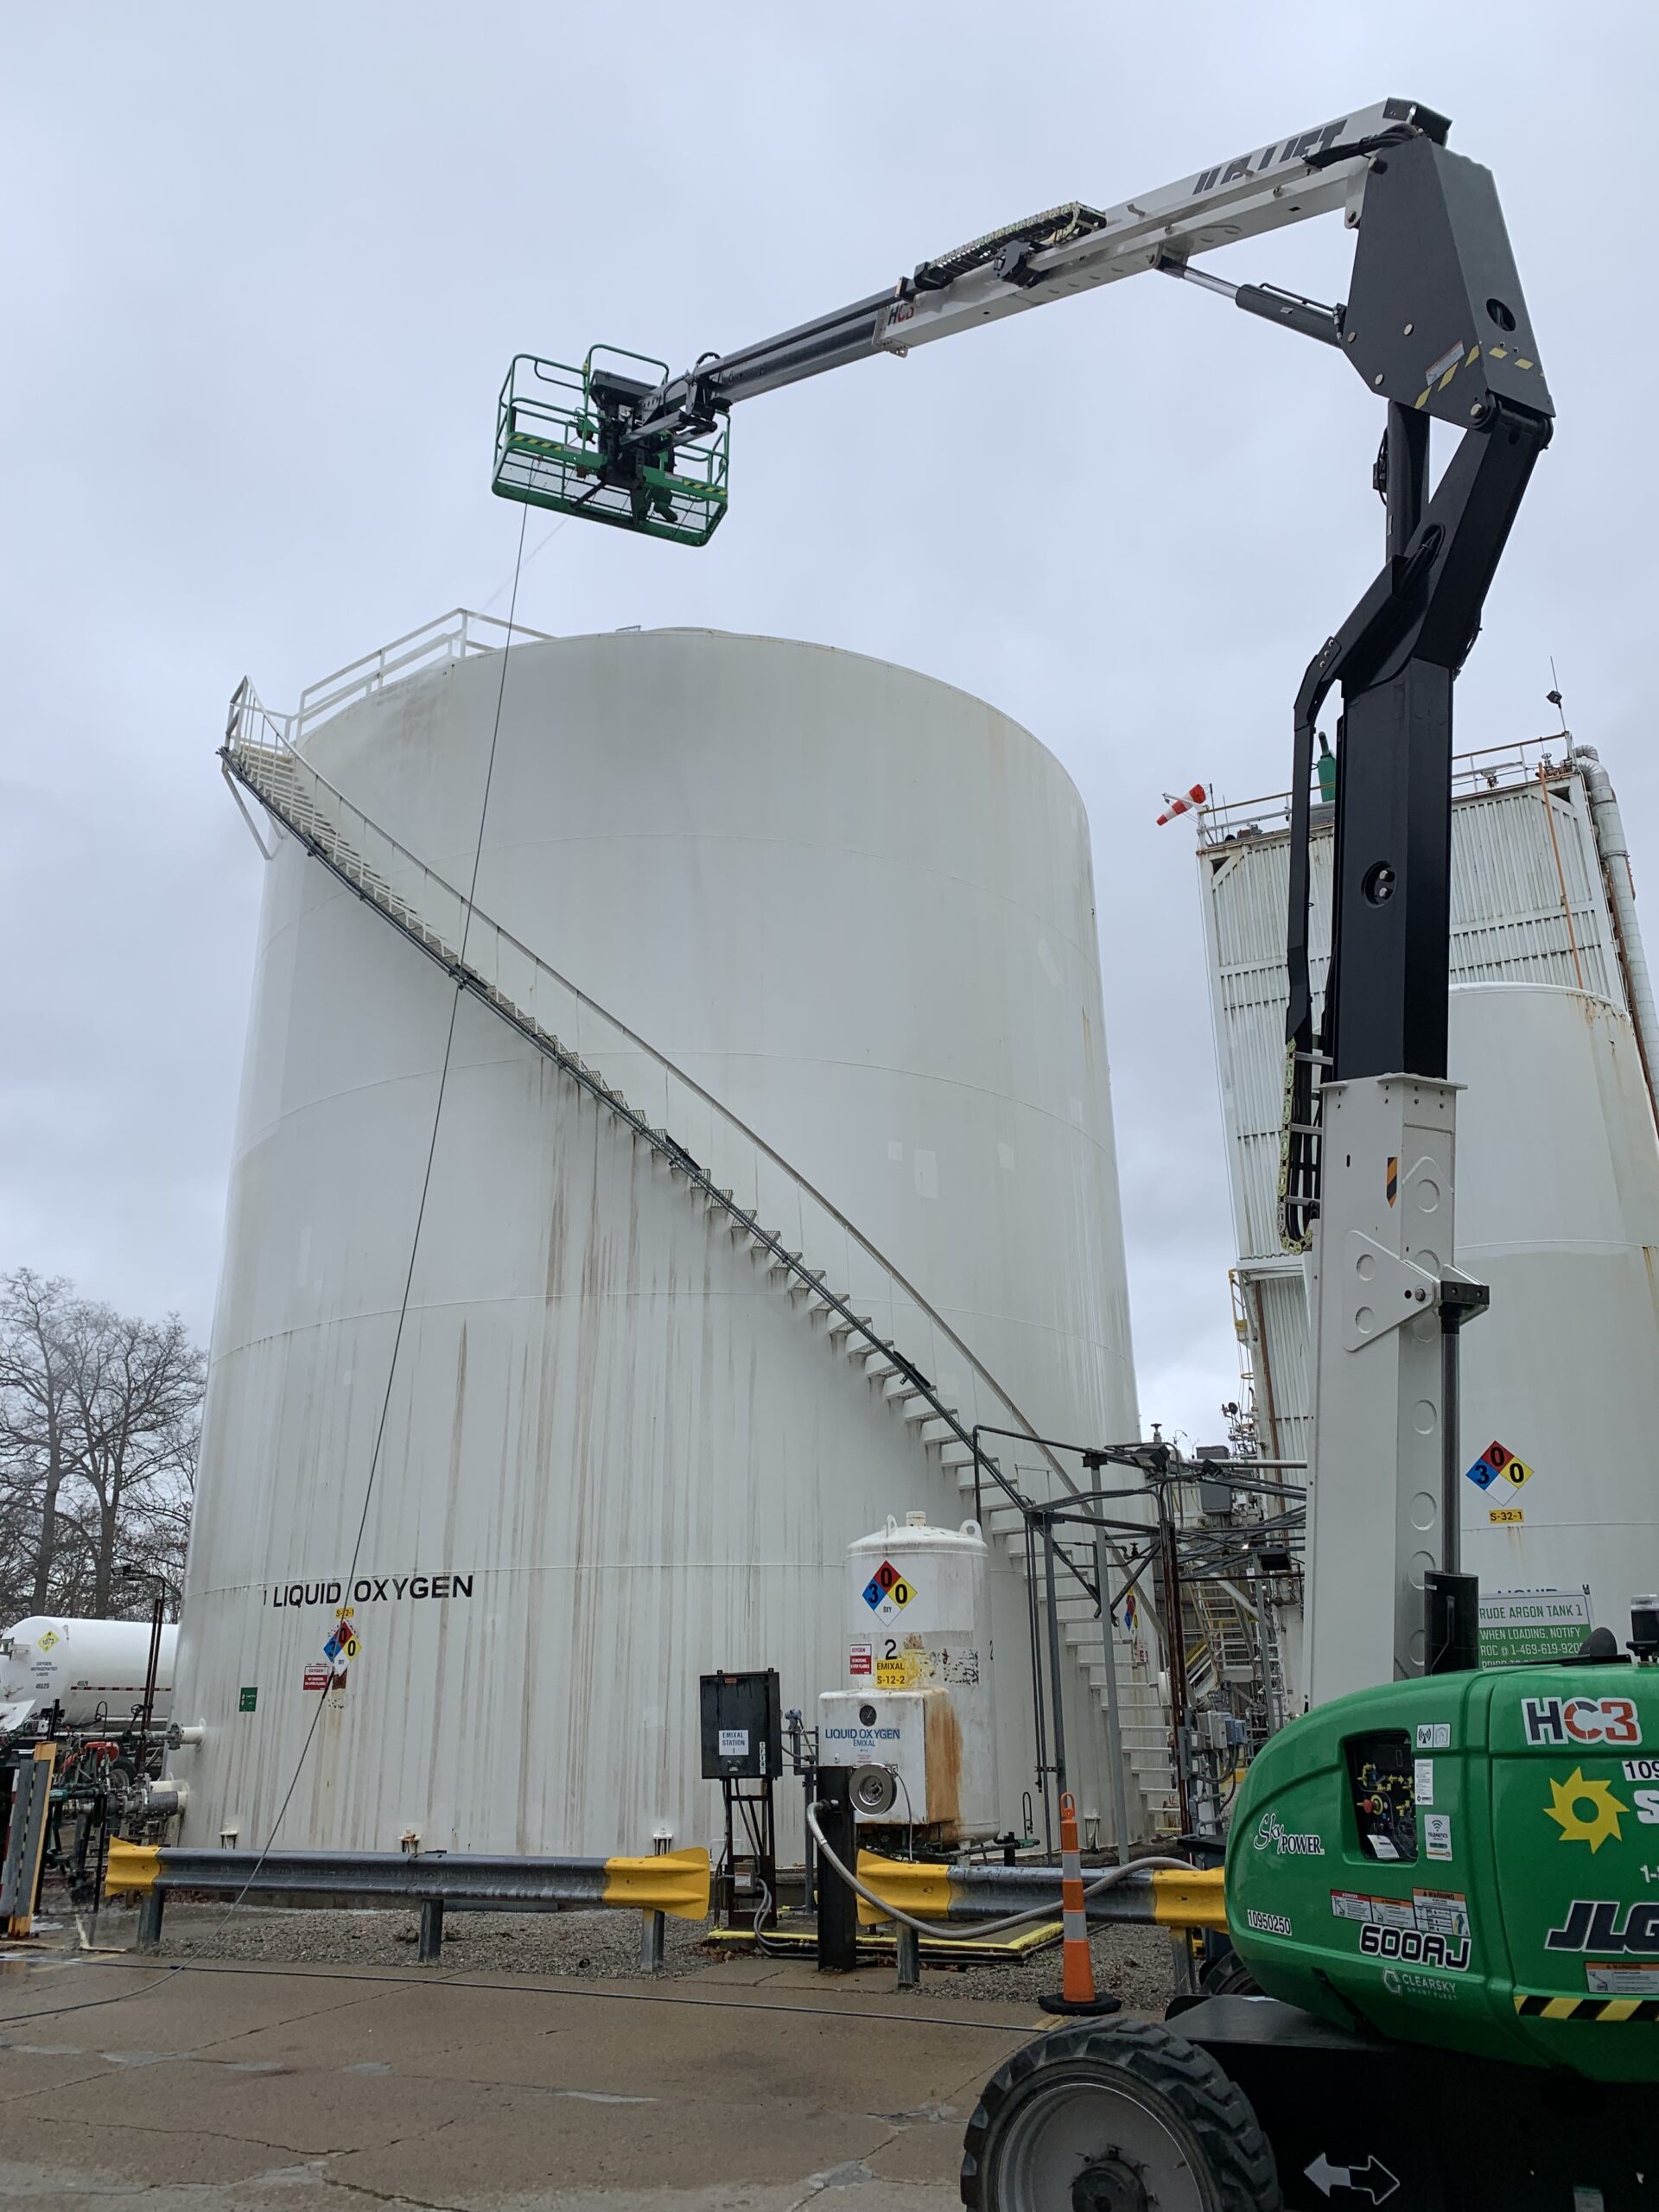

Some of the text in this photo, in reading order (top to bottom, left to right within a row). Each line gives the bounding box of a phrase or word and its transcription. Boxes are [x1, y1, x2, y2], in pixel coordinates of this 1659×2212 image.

[1490, 1446, 1505, 1467] 0
[1474, 1463, 1525, 1484] 3 0
[1490, 1511, 1523, 1522] S-32-1
[880, 1567, 893, 1588] 0
[272, 1582, 342, 1608] LIQUID
[353, 1574, 474, 1603] OXYGEN
[868, 1583, 908, 1604] 3 0
[335, 1608, 354, 1618] S-2-1
[1478, 1604, 1583, 1619] RUDE ARGON TANK 1
[1479, 1626, 1580, 1641] WHEN LOADING, NOTIFY
[347, 1640, 356, 1656] 0
[885, 1639, 897, 1660] 2
[1480, 1645, 1498, 1656] ROC
[877, 1662, 905, 1671] EMIXAL
[877, 1675, 905, 1685] S-12-2
[1522, 1697, 1642, 1745] HC3
[825, 1729, 900, 1739] LIQUID OXYGEN
[1640, 1865, 1659, 1883] 1-
[1248, 1910, 1291, 1936] 10950250
[1544, 1900, 1659, 1955] JLG
[1359, 1922, 1471, 1972] 600AJ
[1402, 1974, 1456, 1993] CLEARSKY
